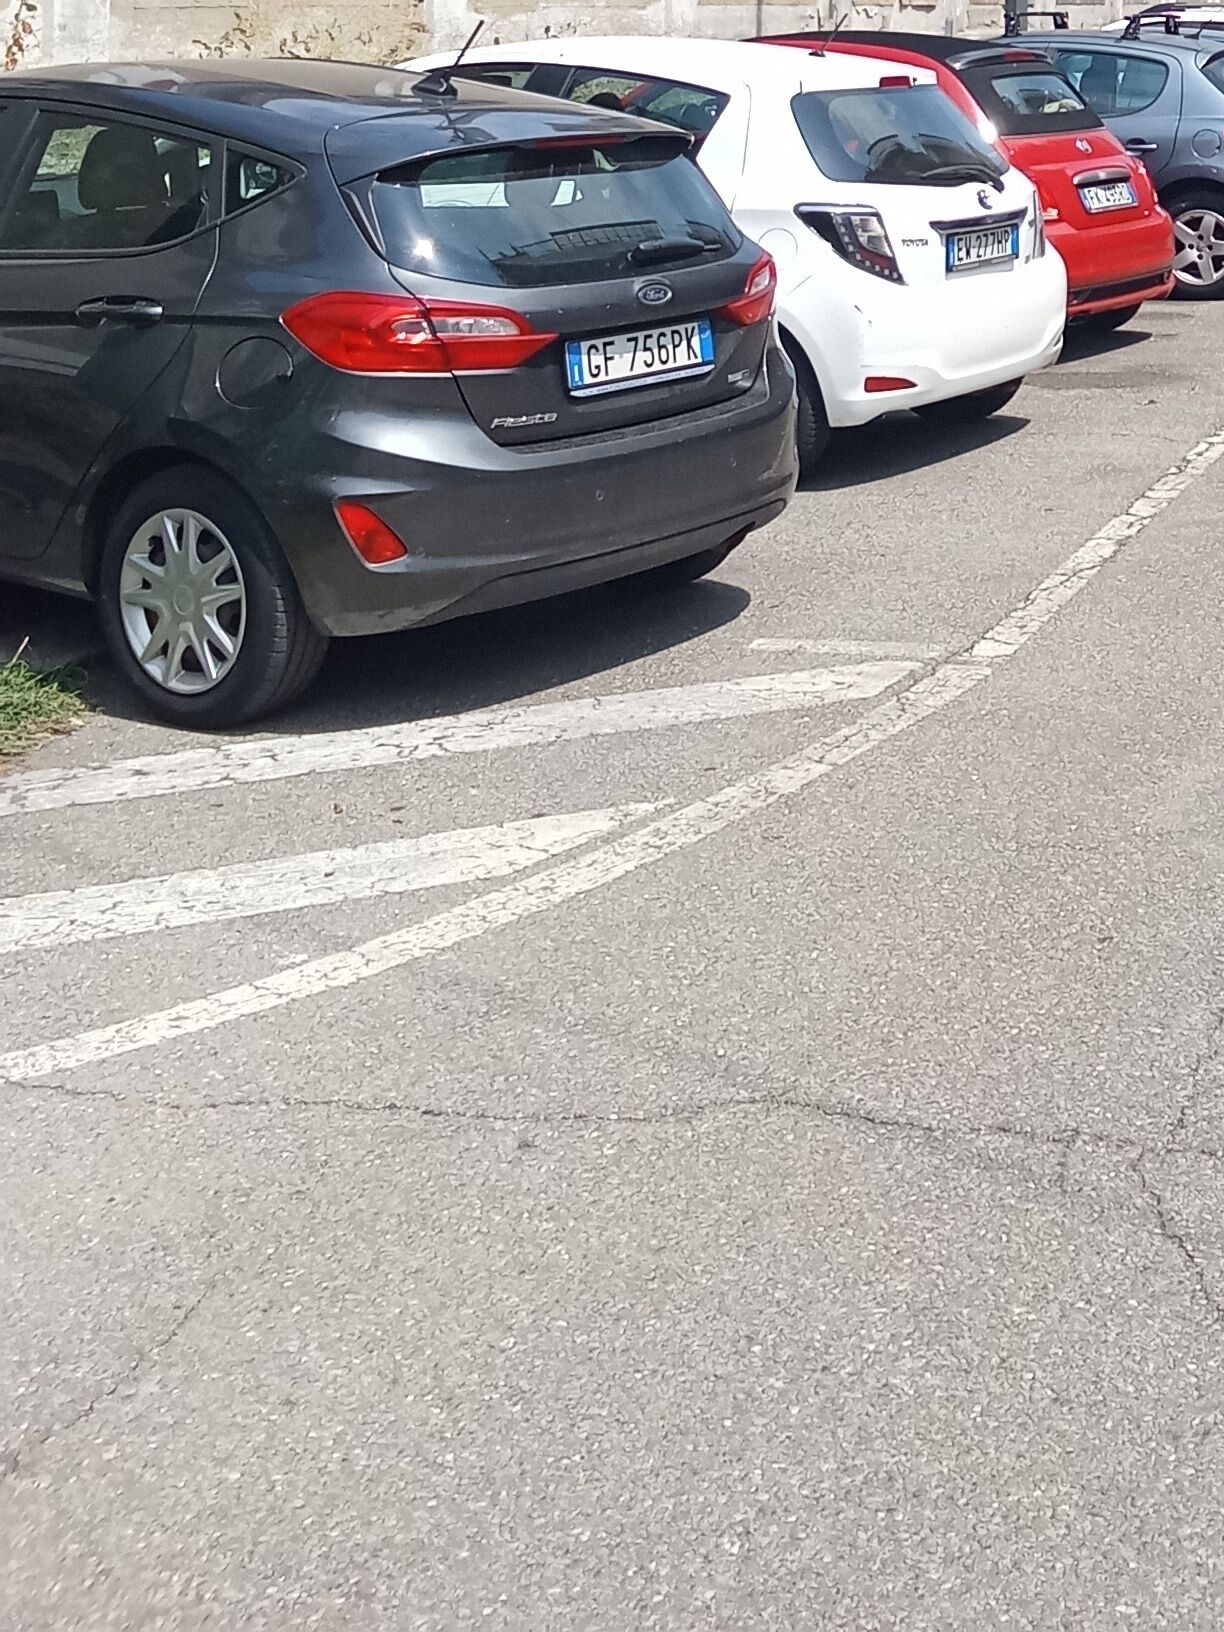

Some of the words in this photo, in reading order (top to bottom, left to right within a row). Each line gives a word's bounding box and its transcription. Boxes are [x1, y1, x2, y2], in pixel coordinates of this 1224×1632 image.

[975, 229, 1010, 259] 277HP
[586, 340, 615, 379] GF
[626, 325, 699, 373] 756PK
[490, 412, 558, 429] Fiesta
